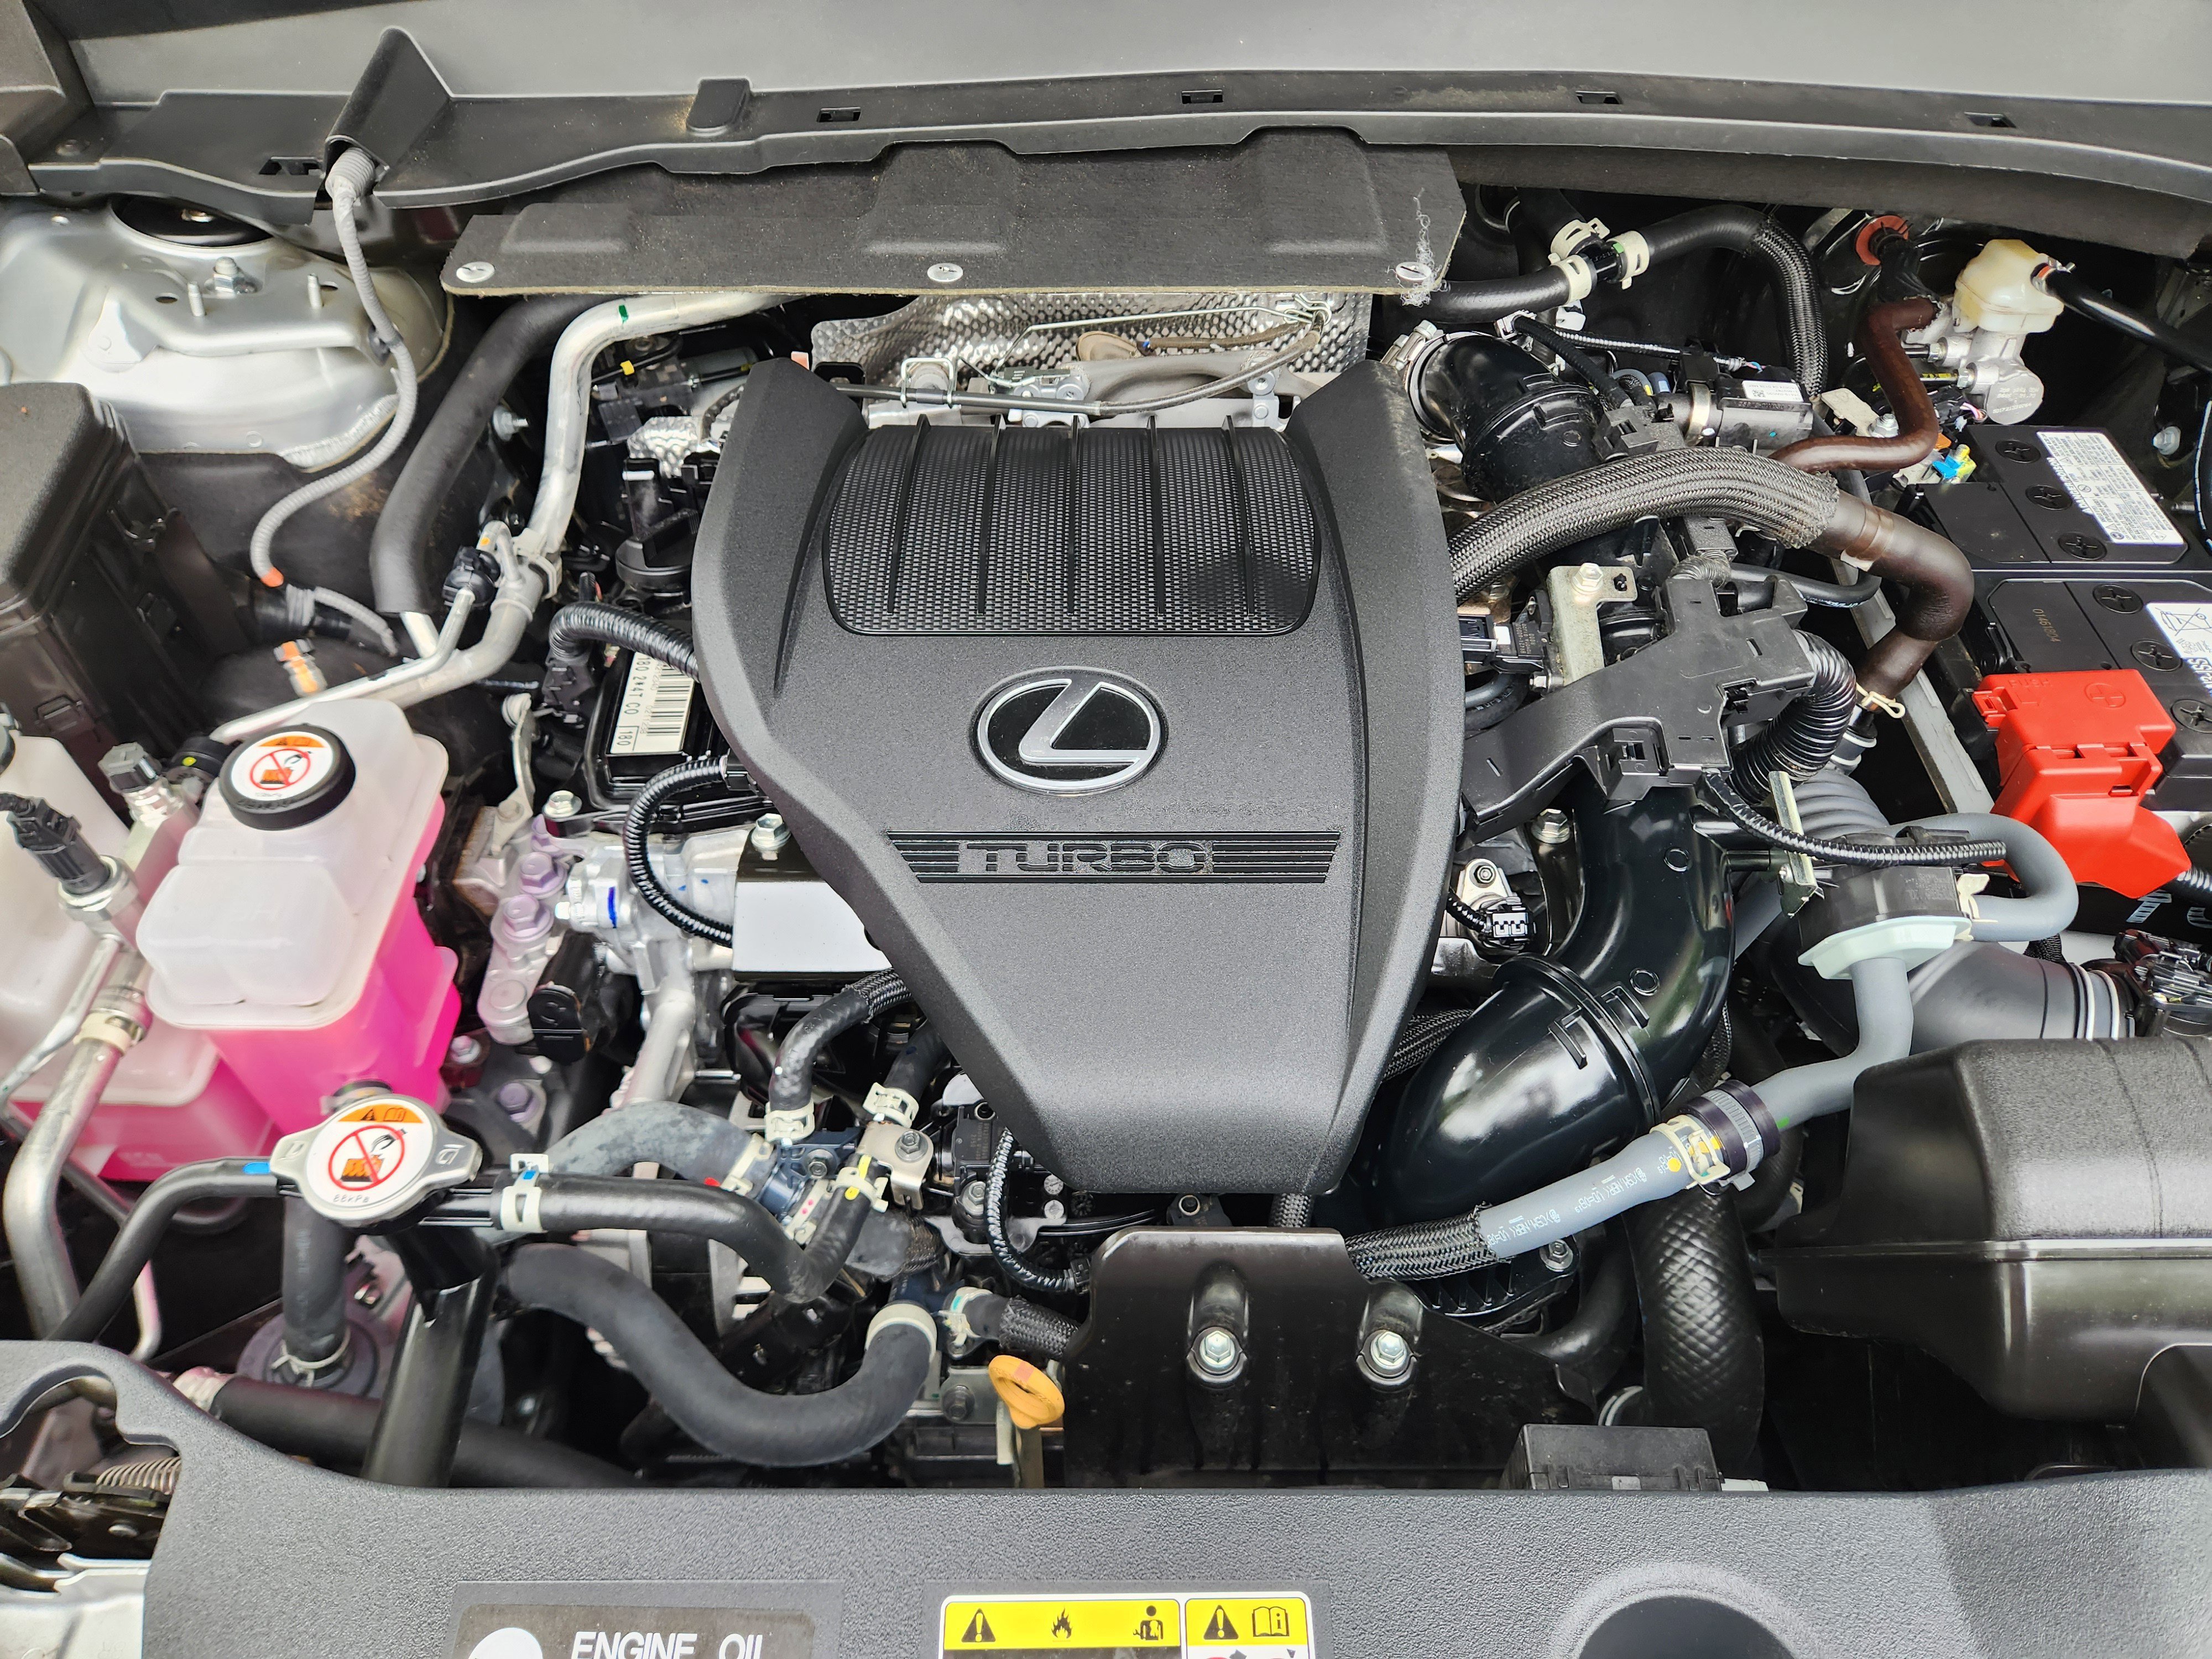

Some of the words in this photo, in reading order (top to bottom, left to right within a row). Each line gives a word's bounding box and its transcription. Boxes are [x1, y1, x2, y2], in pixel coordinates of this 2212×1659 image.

[637, 657, 651, 671] 180
[2007, 678, 2053, 687] PUSH
[617, 731, 633, 745] 180
[967, 842, 1205, 872] TURBO
